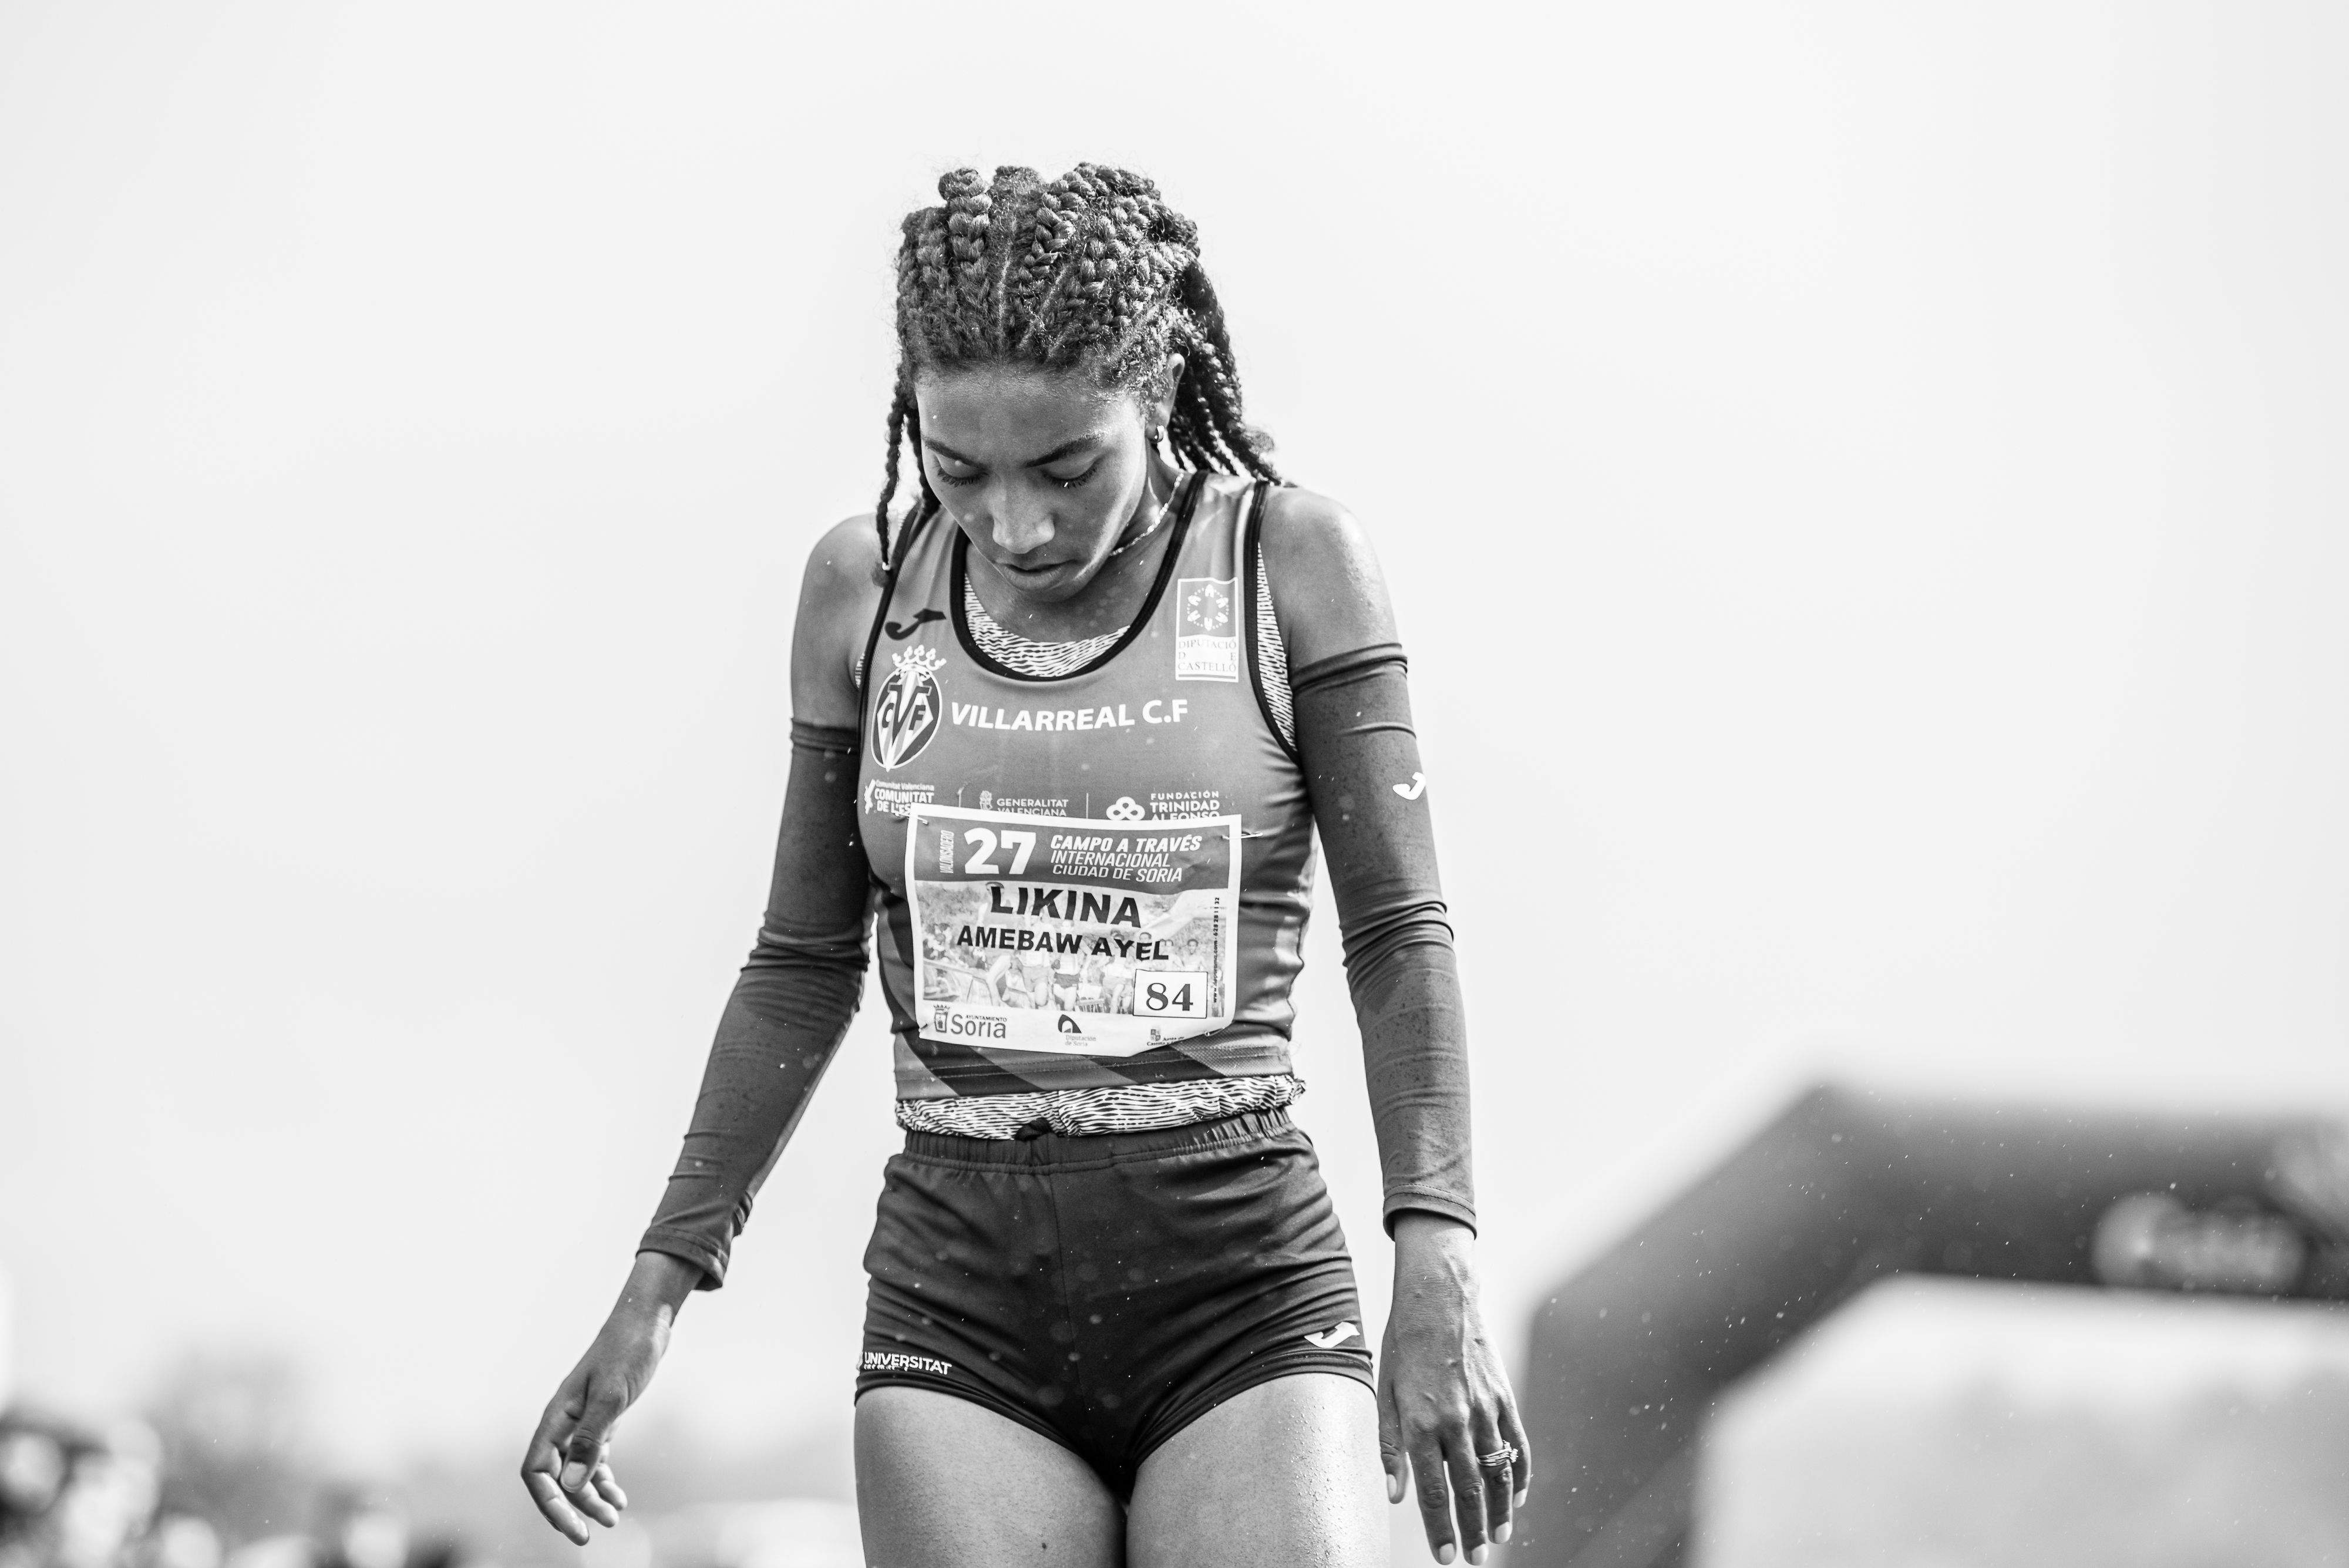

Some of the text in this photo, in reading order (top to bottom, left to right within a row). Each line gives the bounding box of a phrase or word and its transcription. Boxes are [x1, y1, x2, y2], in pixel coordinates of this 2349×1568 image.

[951, 699, 1188, 731] VILLARREAL C.F
[874, 788, 935, 803] COMUNITAT
[997, 798, 1069, 808] GENERALITAT
[1150, 790, 1219, 800] FUNDACIÓN
[877, 800, 911, 815] DE L'ES
[1150, 799, 1220, 813] TRINIDAD
[964, 827, 1036, 875] 27
[1050, 834, 1203, 853] CAMPO A TRAVÉS
[1050, 850, 1171, 868] INTERNACIONAL
[1052, 864, 1183, 883] CIUDAD DE SORIA
[990, 886, 1141, 928] LIKINA
[957, 925, 1169, 961] AMEBAW AYEL
[1146, 982, 1193, 1011] 84
[951, 1014, 1006, 1039] Soria
[864, 1351, 953, 1375] UNIVERSITAT
